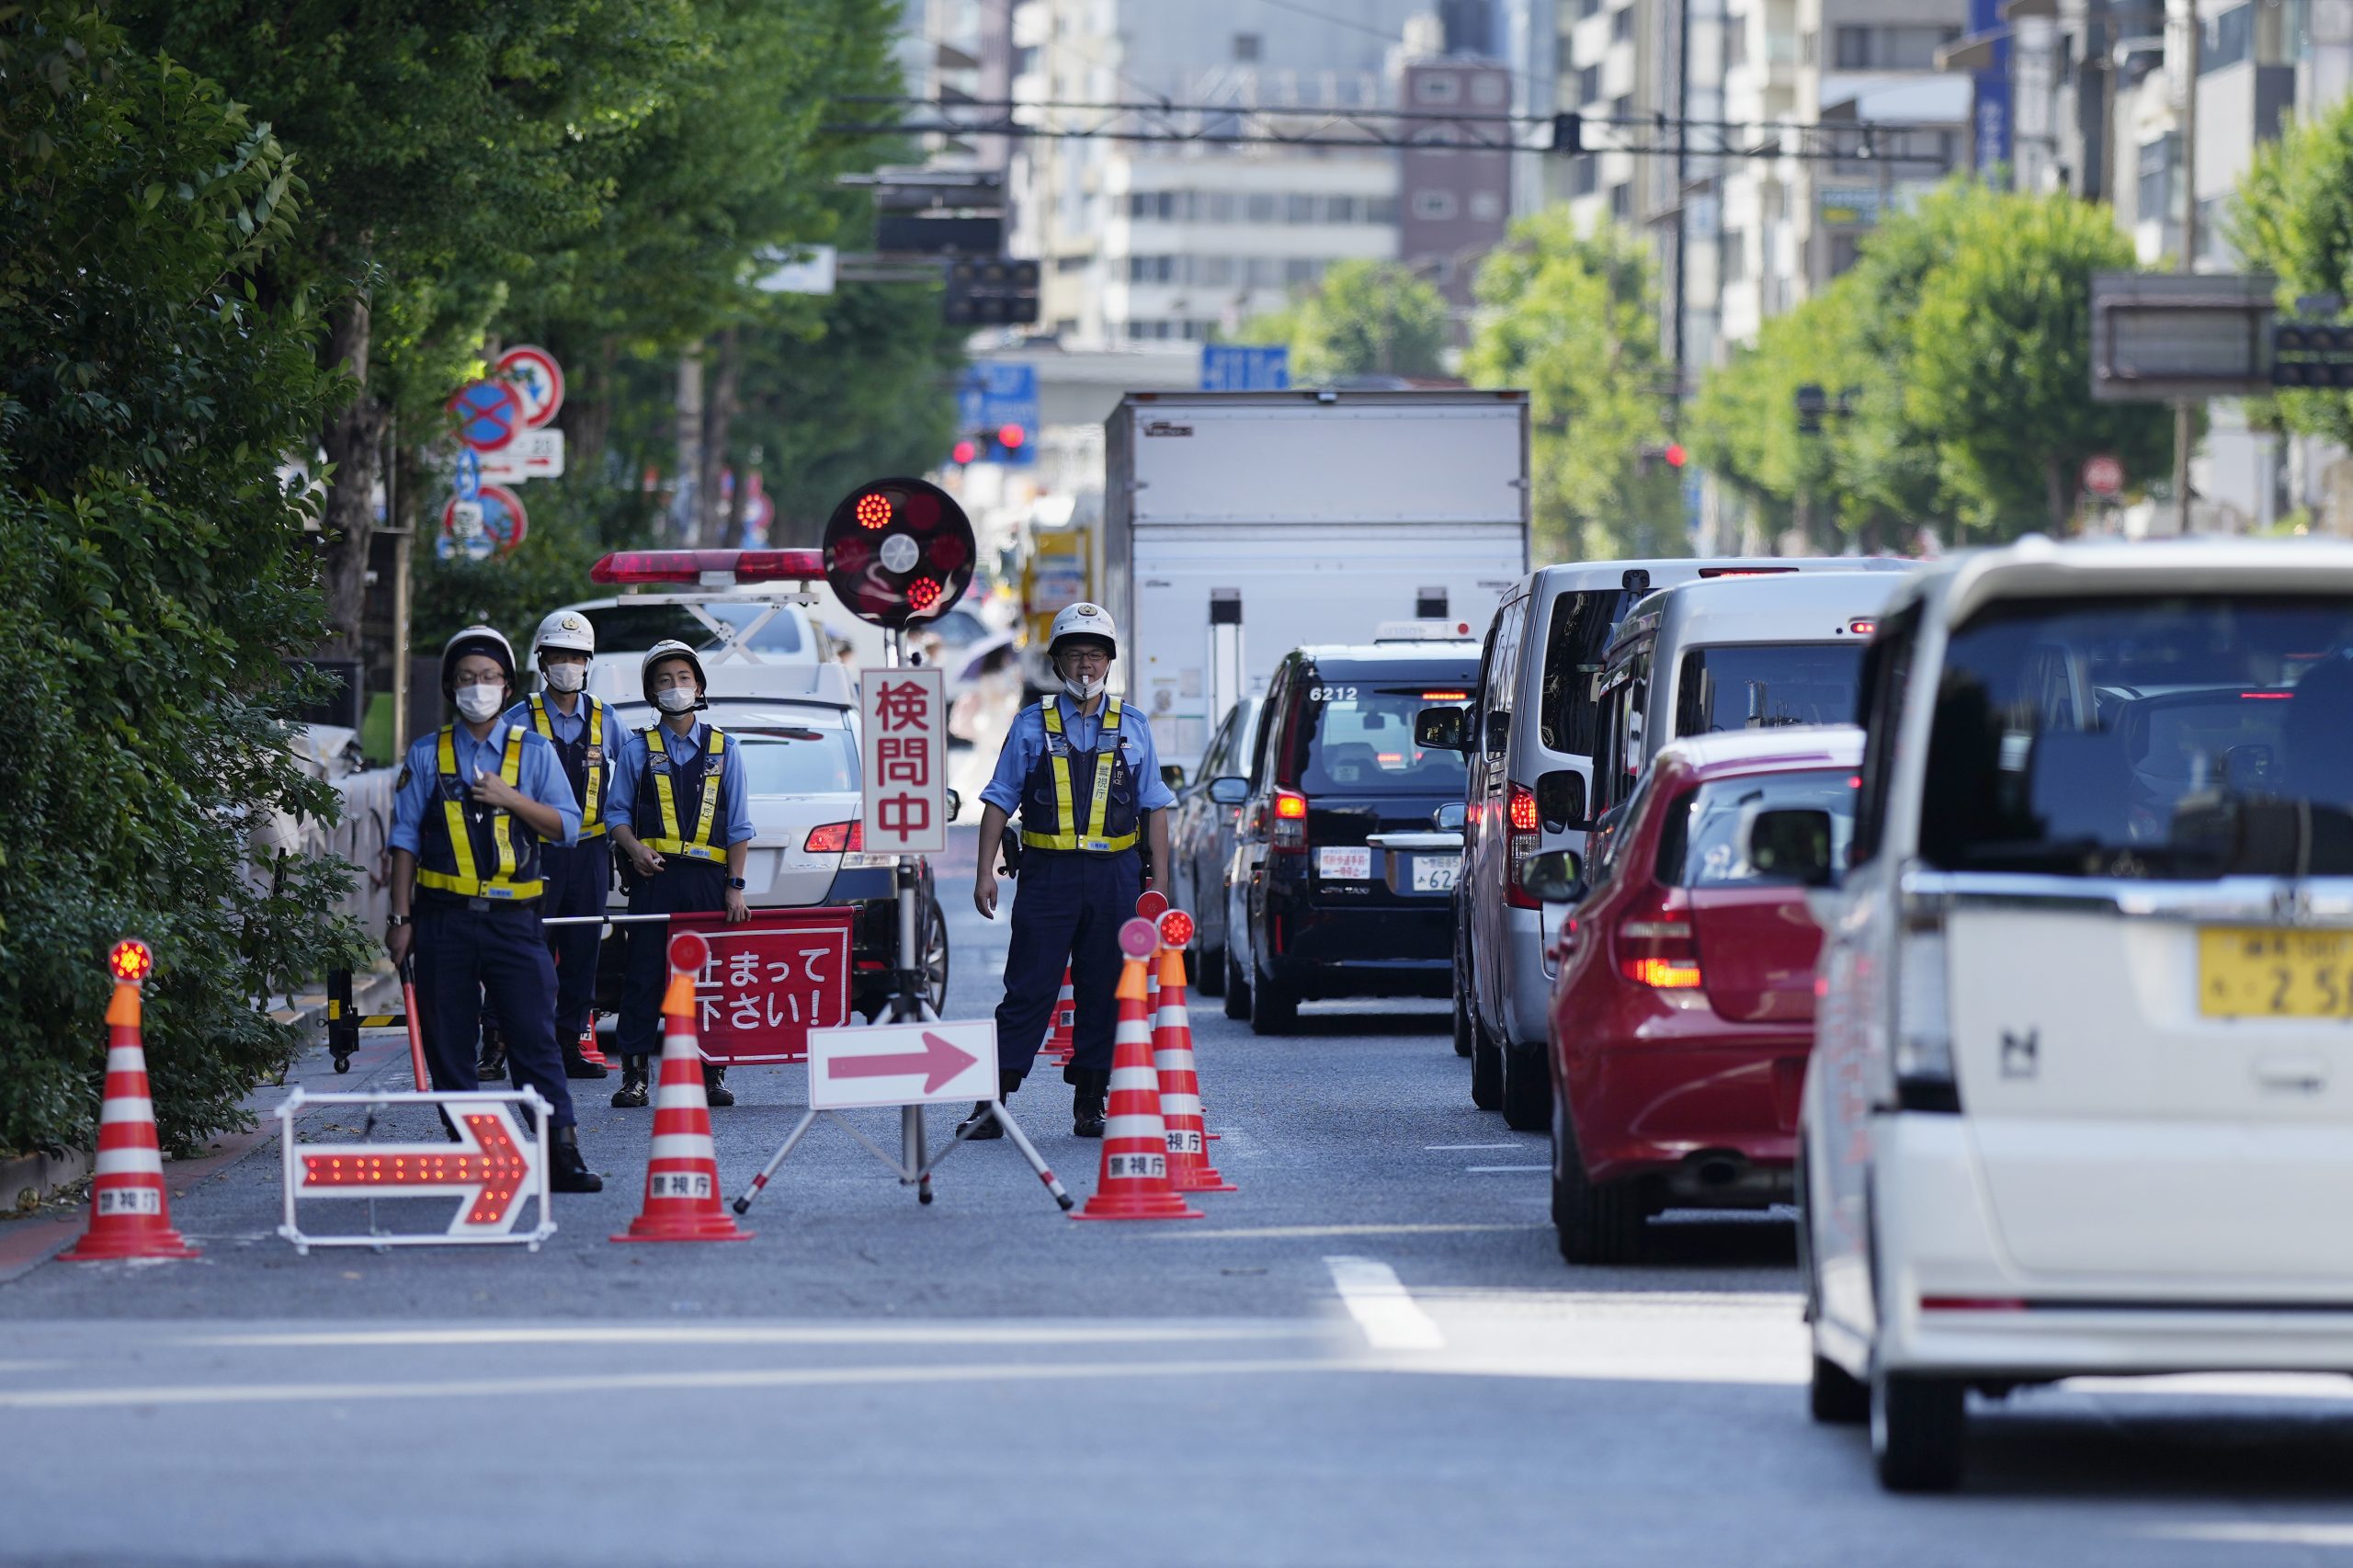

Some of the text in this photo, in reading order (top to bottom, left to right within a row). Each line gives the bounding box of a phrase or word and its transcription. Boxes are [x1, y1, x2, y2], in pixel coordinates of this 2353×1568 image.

[1309, 687, 1358, 701] 6212
[876, 681, 929, 842] 検問中
[1095, 765, 1110, 800] 警視庁
[695, 947, 831, 988] 止まって
[2268, 966, 2353, 1014] 25
[695, 990, 821, 1032] 下さい!
[1110, 1156, 1165, 1176] 警視庁
[654, 1176, 710, 1195] 警視庁
